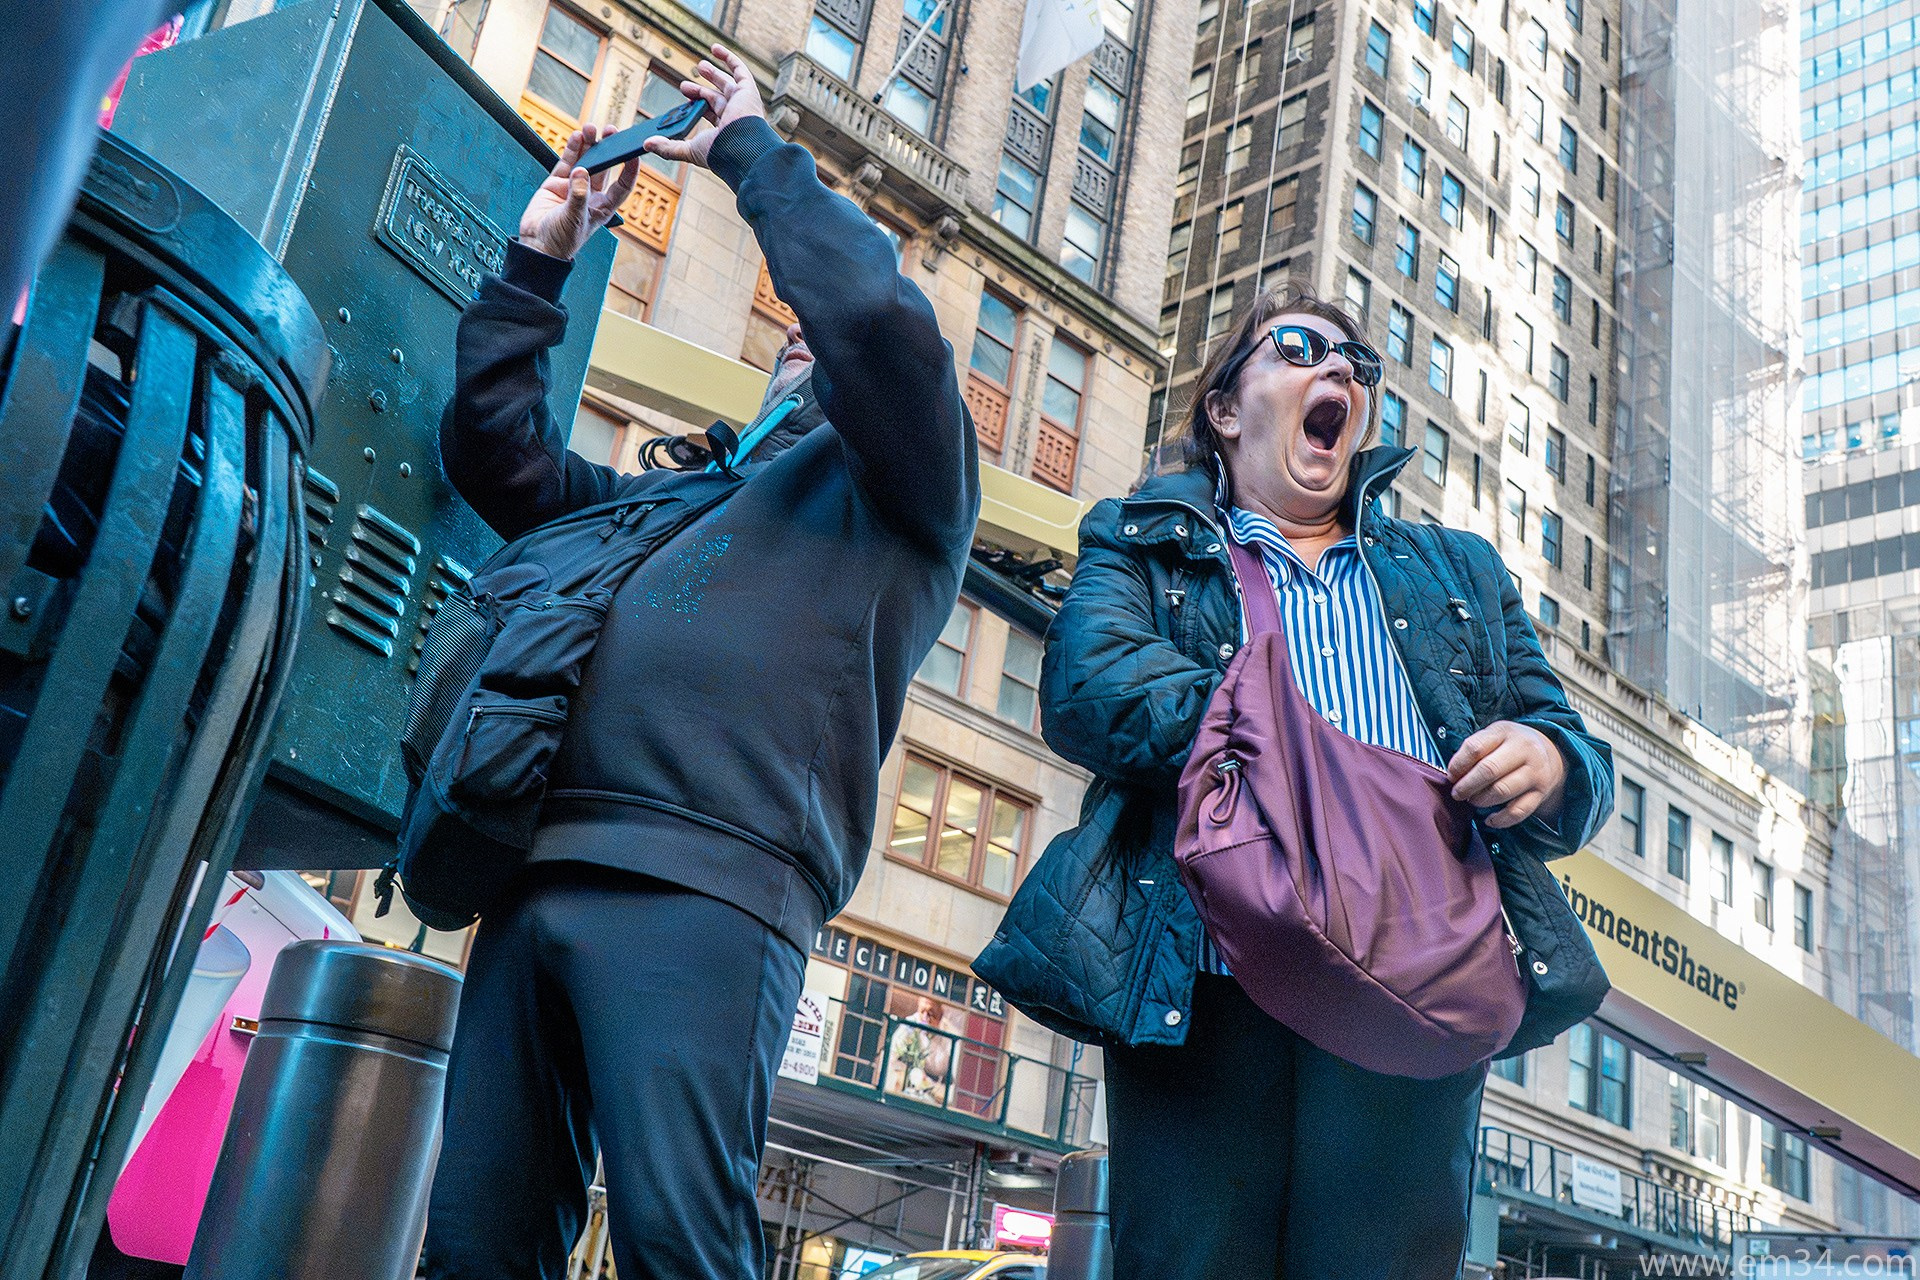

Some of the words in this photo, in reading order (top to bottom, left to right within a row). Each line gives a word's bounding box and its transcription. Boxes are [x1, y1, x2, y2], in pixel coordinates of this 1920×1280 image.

[405, 176, 471, 247] TRAFFIC
[406, 214, 446, 257] NEW
[815, 931, 948, 995] LECTION
[1557, 874, 1739, 1010] ipmentShare
